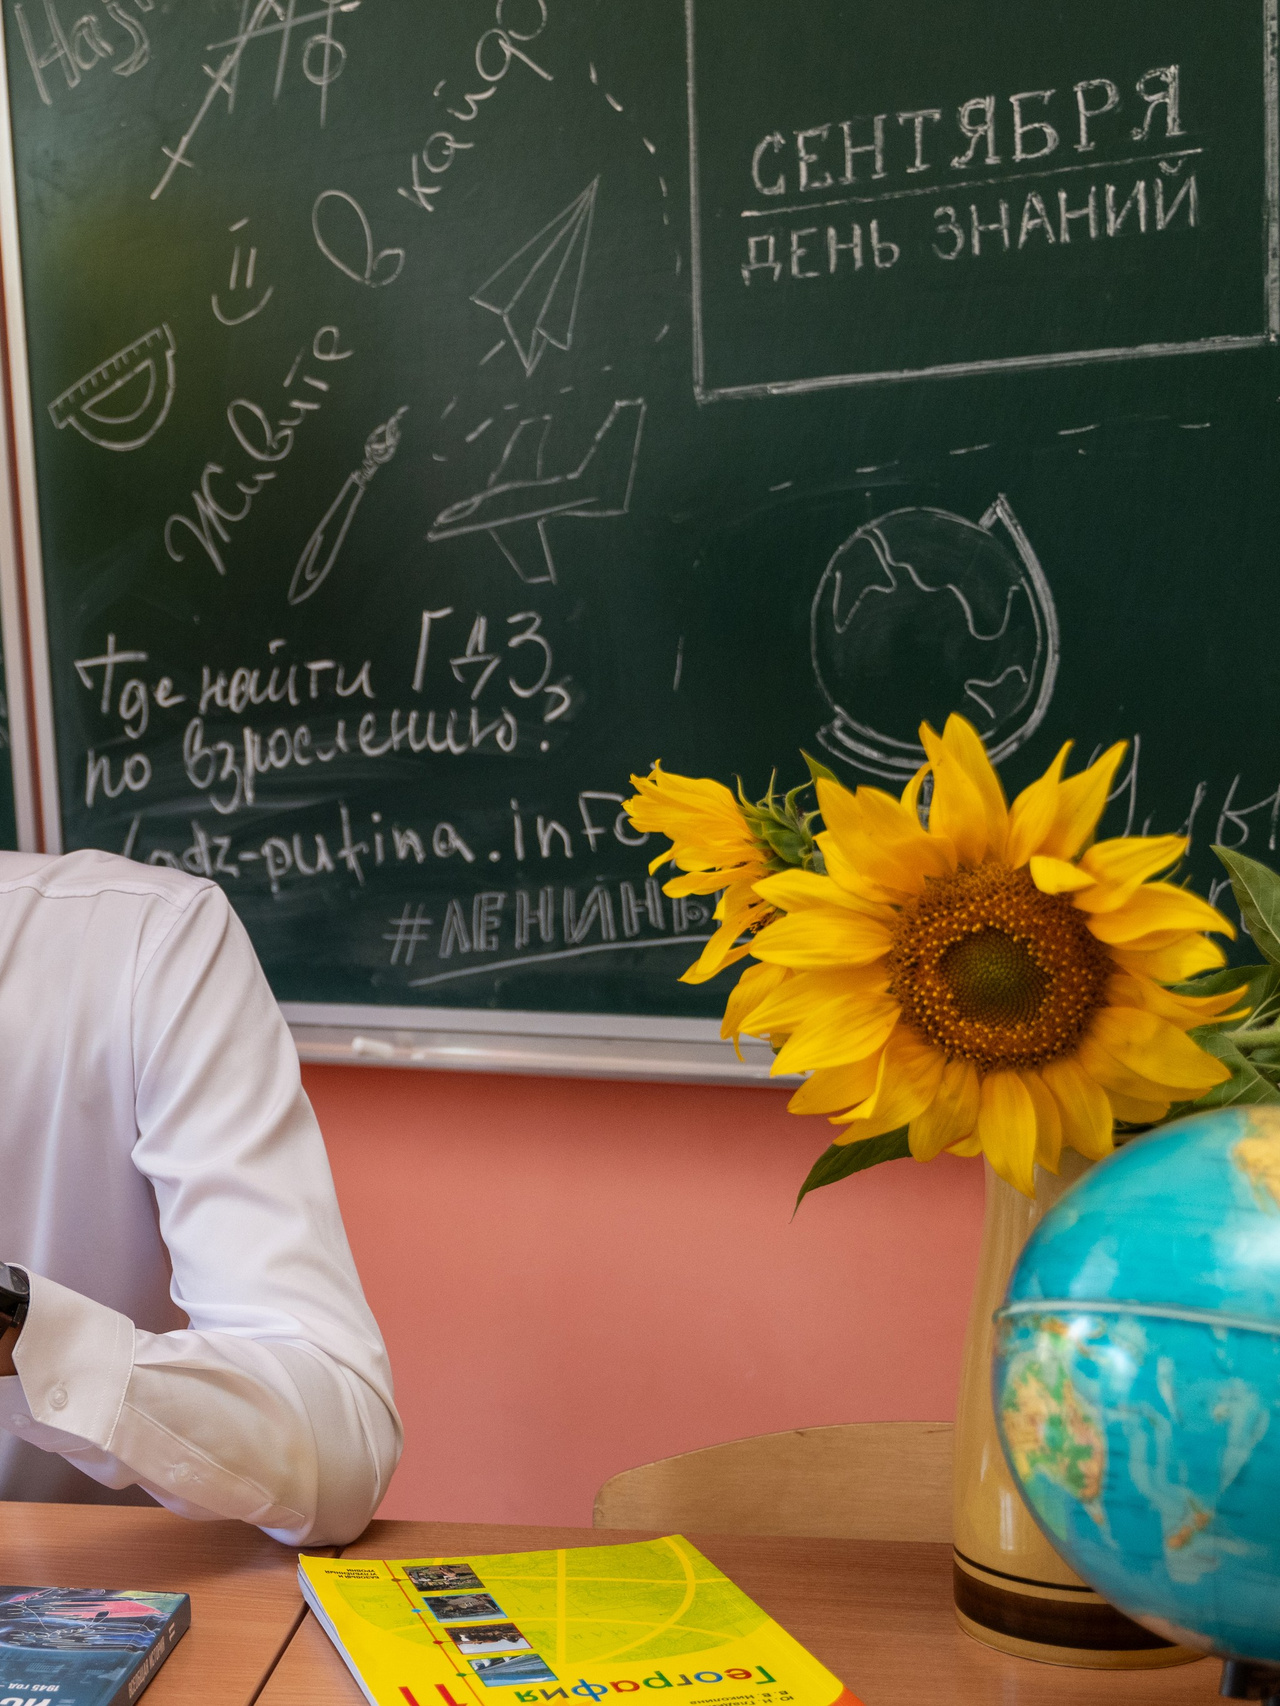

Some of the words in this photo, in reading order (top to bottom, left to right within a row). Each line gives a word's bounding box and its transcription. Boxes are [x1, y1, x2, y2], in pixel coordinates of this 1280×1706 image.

[750, 64, 1187, 196] СЕНТЯБРЯ
[741, 219, 901, 286] ДЕНЬ
[932, 157, 1200, 260] ЗНАНИЙ
[199, 639, 376, 714] найти
[412, 607, 553, 700] ГДЗ
[86, 748, 152, 808] по
[8, 1682, 30, 1690] год
[32, 1683, 60, 1692] 1945
[514, 1665, 778, 1703] География
